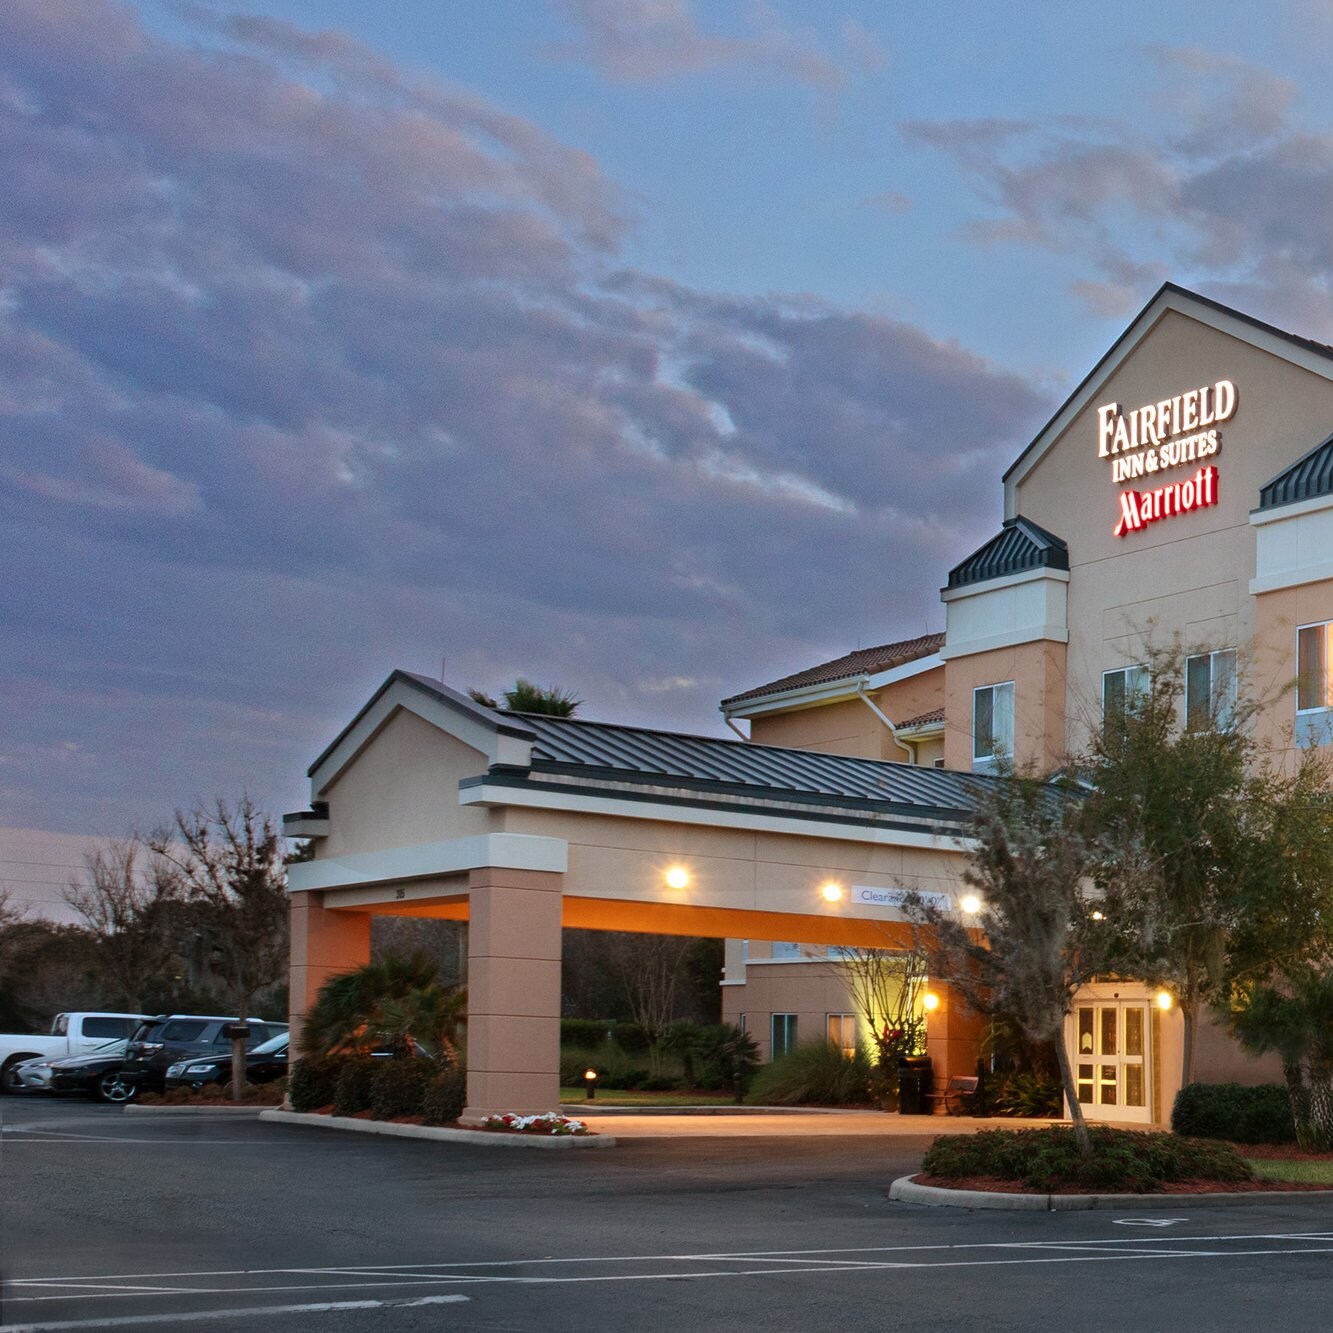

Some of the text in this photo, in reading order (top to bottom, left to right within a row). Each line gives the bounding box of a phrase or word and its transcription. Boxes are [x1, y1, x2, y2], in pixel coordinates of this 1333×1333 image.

[1098, 379, 1237, 457] FAIRFIELD
[1160, 429, 1218, 467] SUITES
[1114, 466, 1216, 537] Marriott
[861, 890, 911, 905] Clearanc
